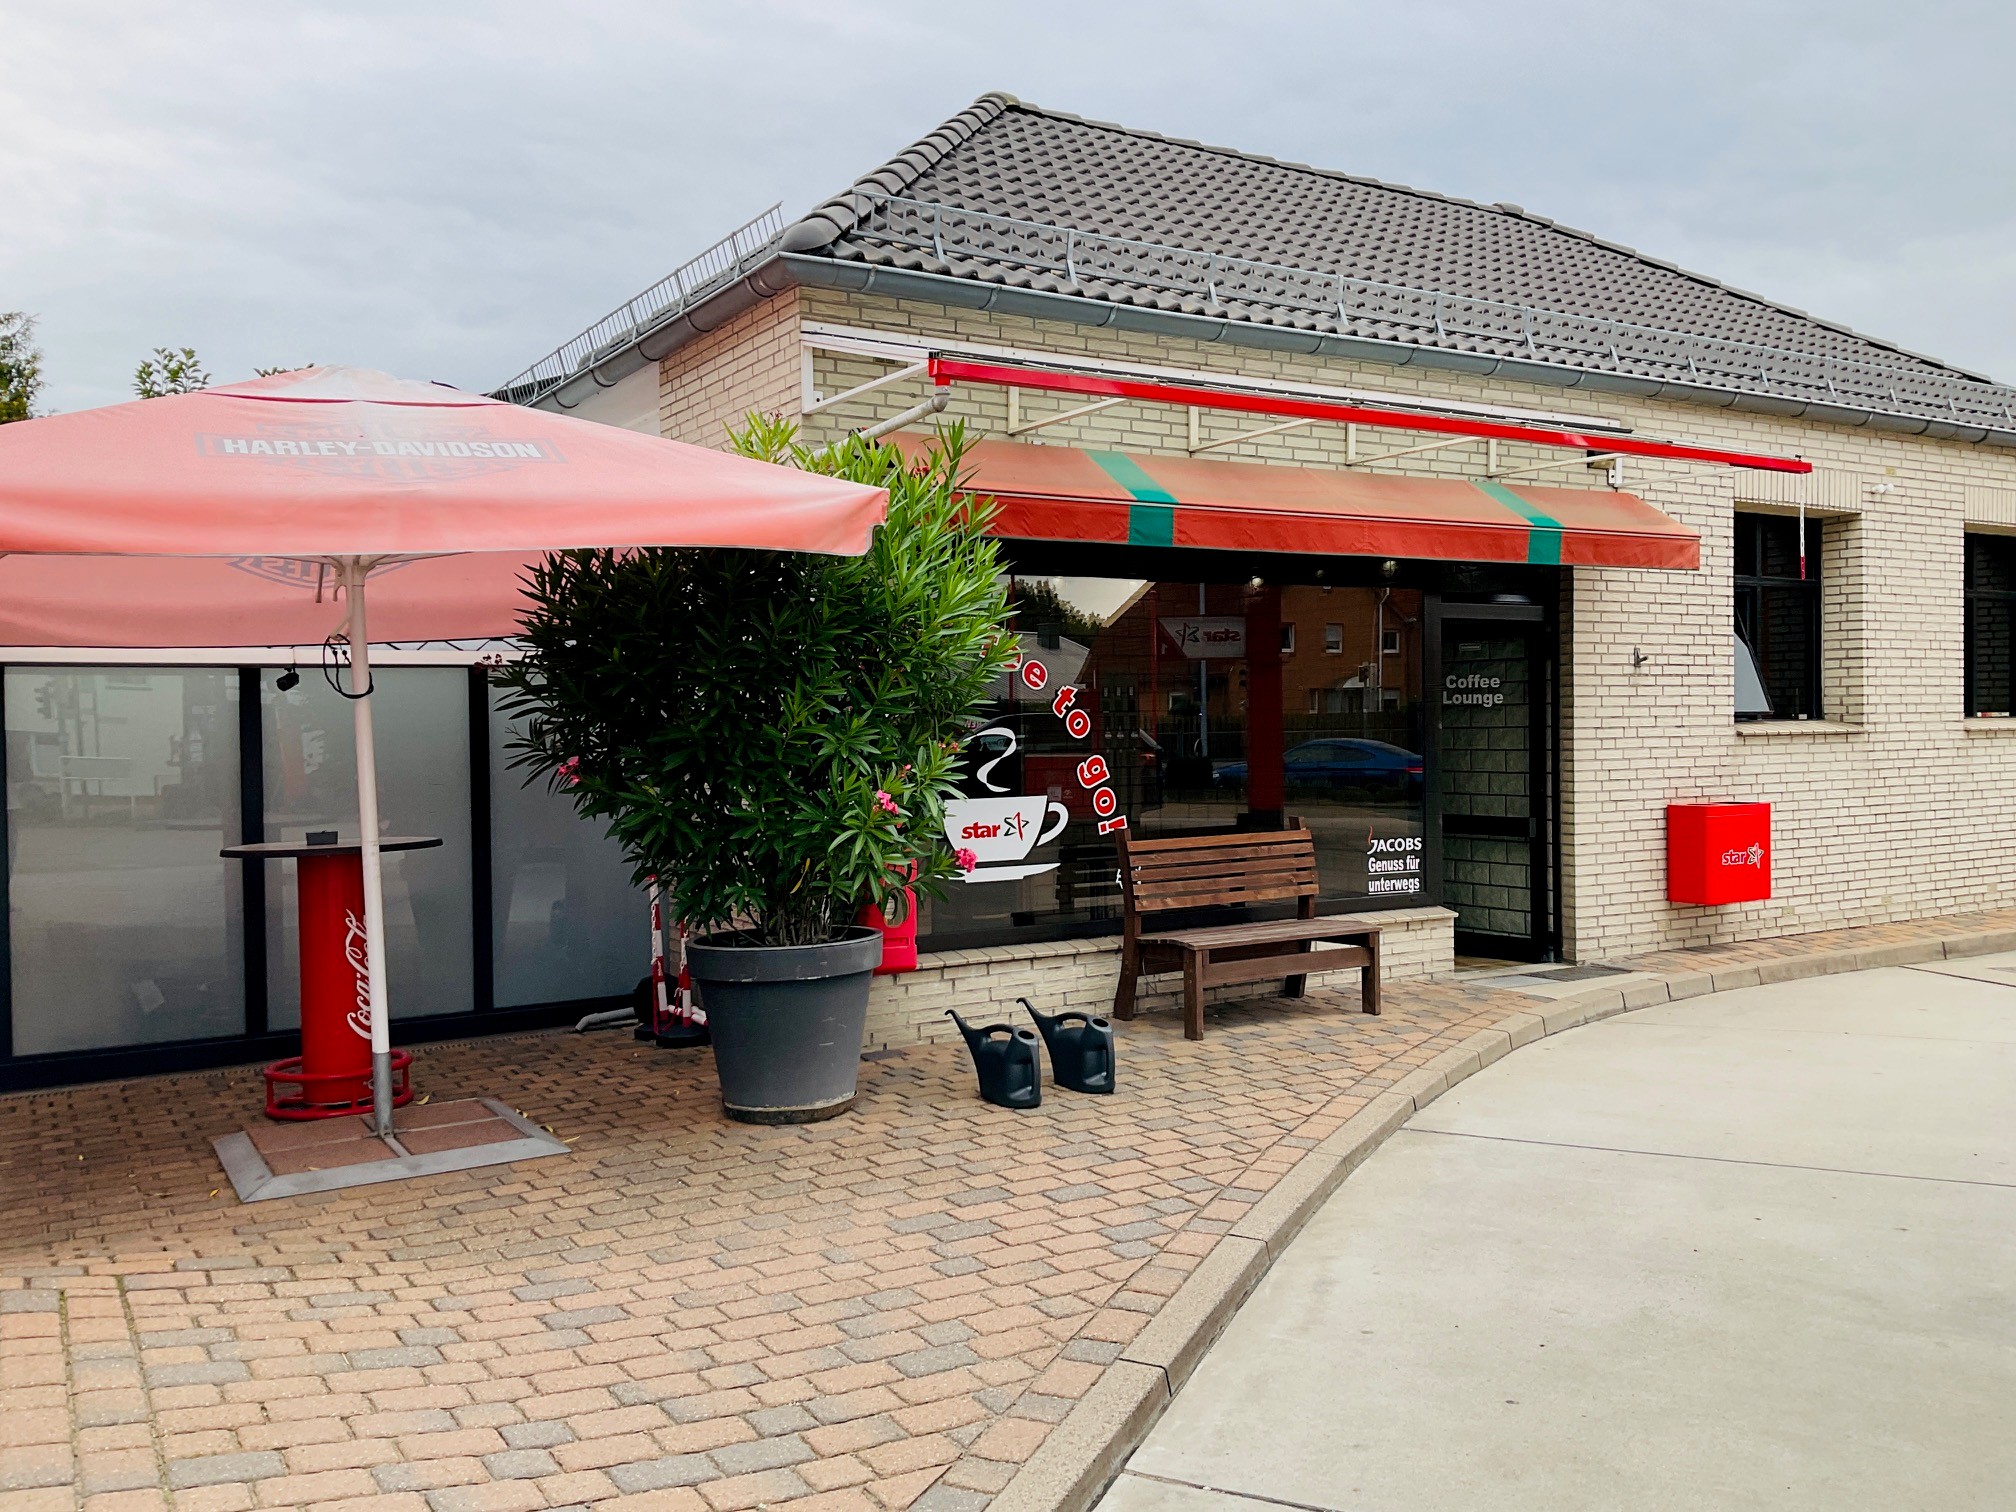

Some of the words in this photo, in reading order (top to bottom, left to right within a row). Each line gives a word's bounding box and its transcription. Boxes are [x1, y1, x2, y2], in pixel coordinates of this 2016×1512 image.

[223, 438, 542, 458] HARLEY-DAVIDSON
[1445, 674, 1501, 689] Coffee
[1442, 691, 1504, 708] Lounge
[1053, 685, 1090, 739] to
[1077, 755, 1127, 835] go!
[961, 822, 1001, 839] star
[1367, 837, 1422, 855] JACOBS
[1368, 857, 1404, 872] Genuss
[1406, 855, 1420, 870] für
[1722, 849, 1747, 866] star
[1368, 877, 1420, 893] unterwegs
